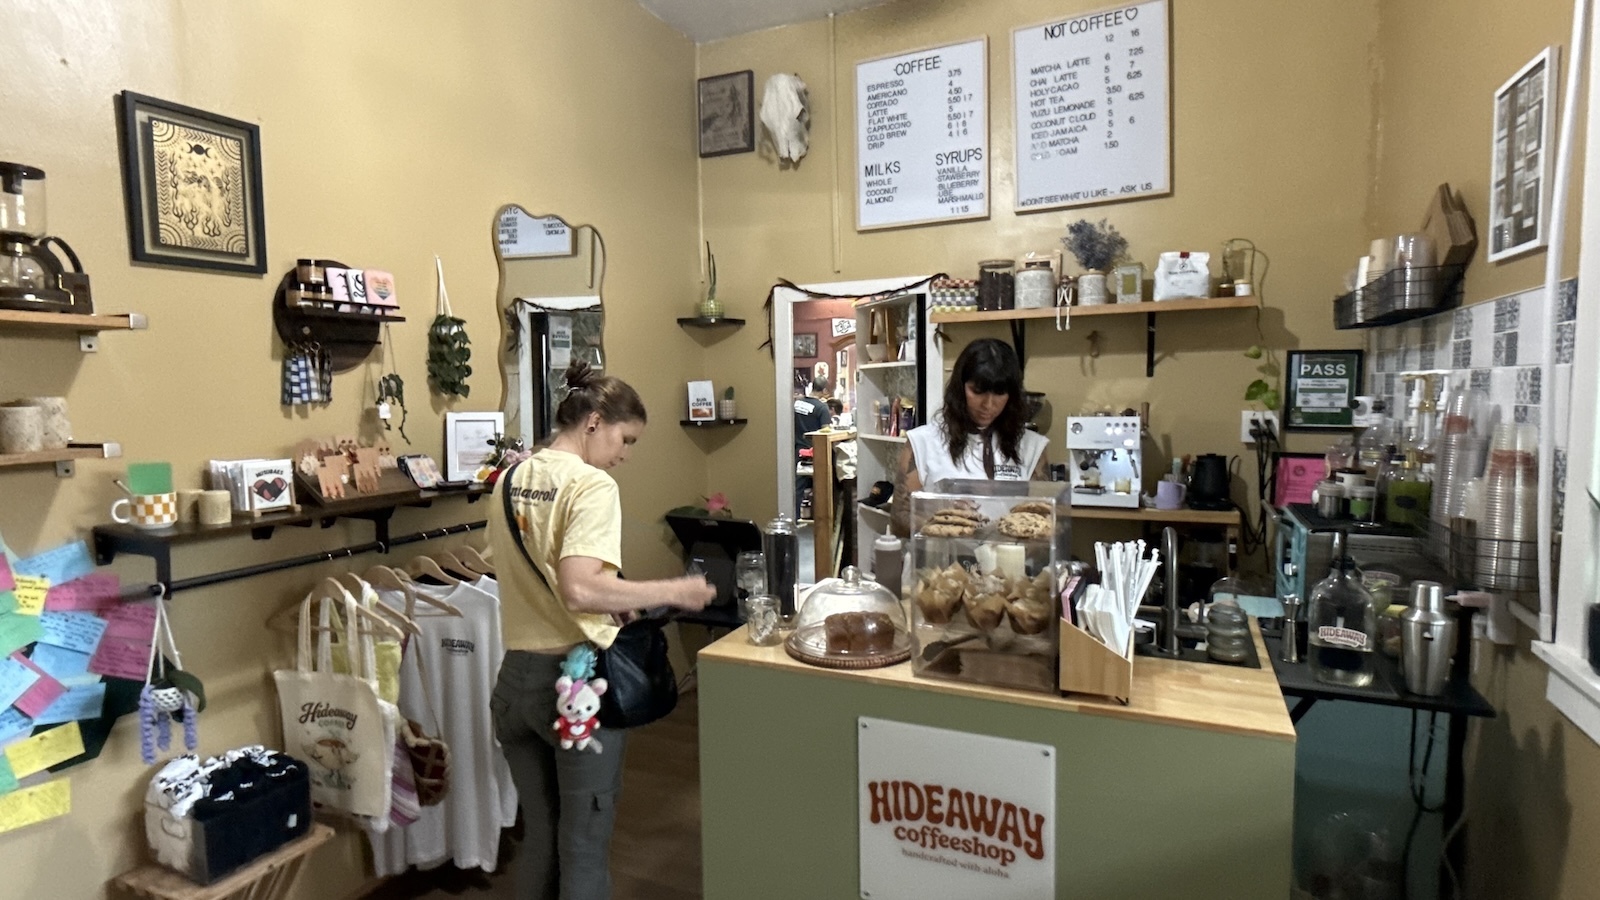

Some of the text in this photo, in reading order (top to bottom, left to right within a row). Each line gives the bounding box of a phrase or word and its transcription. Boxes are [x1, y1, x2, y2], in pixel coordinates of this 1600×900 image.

[1044, 10, 1123, 40] NOT COFFEE
[1105, 29, 1140, 42] 12 16
[1030, 63, 1061, 75] MATCHA
[1067, 57, 1090, 68] LATTE
[867, 80, 904, 92] ESPRESSO
[1030, 78, 1047, 88] CHAI
[1054, 72, 1078, 84] LATTE
[867, 88, 908, 101] AMERICANO
[867, 98, 898, 110] CORTADO
[1030, 98, 1046, 108] HOT
[1049, 96, 1065, 105] TEA
[868, 108, 888, 118] LATTE
[1030, 108, 1050, 118] YUZU
[1054, 100, 1096, 114] LEMONADE
[868, 116, 885, 126] FLAT
[887, 113, 907, 123] WHITE
[1069, 112, 1096, 124] CLOUD
[867, 120, 912, 134] CAPPUCCINO
[1031, 131, 1048, 140] ICED
[1050, 124, 1087, 137] JAMAICA
[867, 133, 885, 142] COLD
[886, 130, 907, 139] BREW
[1049, 136, 1080, 147] MATCHA
[868, 142, 884, 150] DRIP
[936, 147, 983, 166] SYRUPS
[865, 160, 901, 177] MILKS
[937, 165, 967, 175] VANILLA
[866, 178, 892, 188] WHOLE
[938, 179, 979, 190] BLUEBERRY
[1091, 189, 1108, 197] LIKE
[1120, 185, 1137, 193] ASK
[1141, 182, 1152, 191] US
[866, 186, 898, 197] COCONUT
[866, 196, 894, 205] ALMOND
[1301, 364, 1346, 376] PASS
[1320, 628, 1365, 644] HIDEAWAY
[442, 638, 474, 653] HIDEAWAY
[299, 702, 358, 730] Hideaway
[868, 780, 1045, 860] HIDEAWAY
[894, 826, 1016, 866] coffeeshop
[902, 848, 1010, 879] handcrafted with aloha
